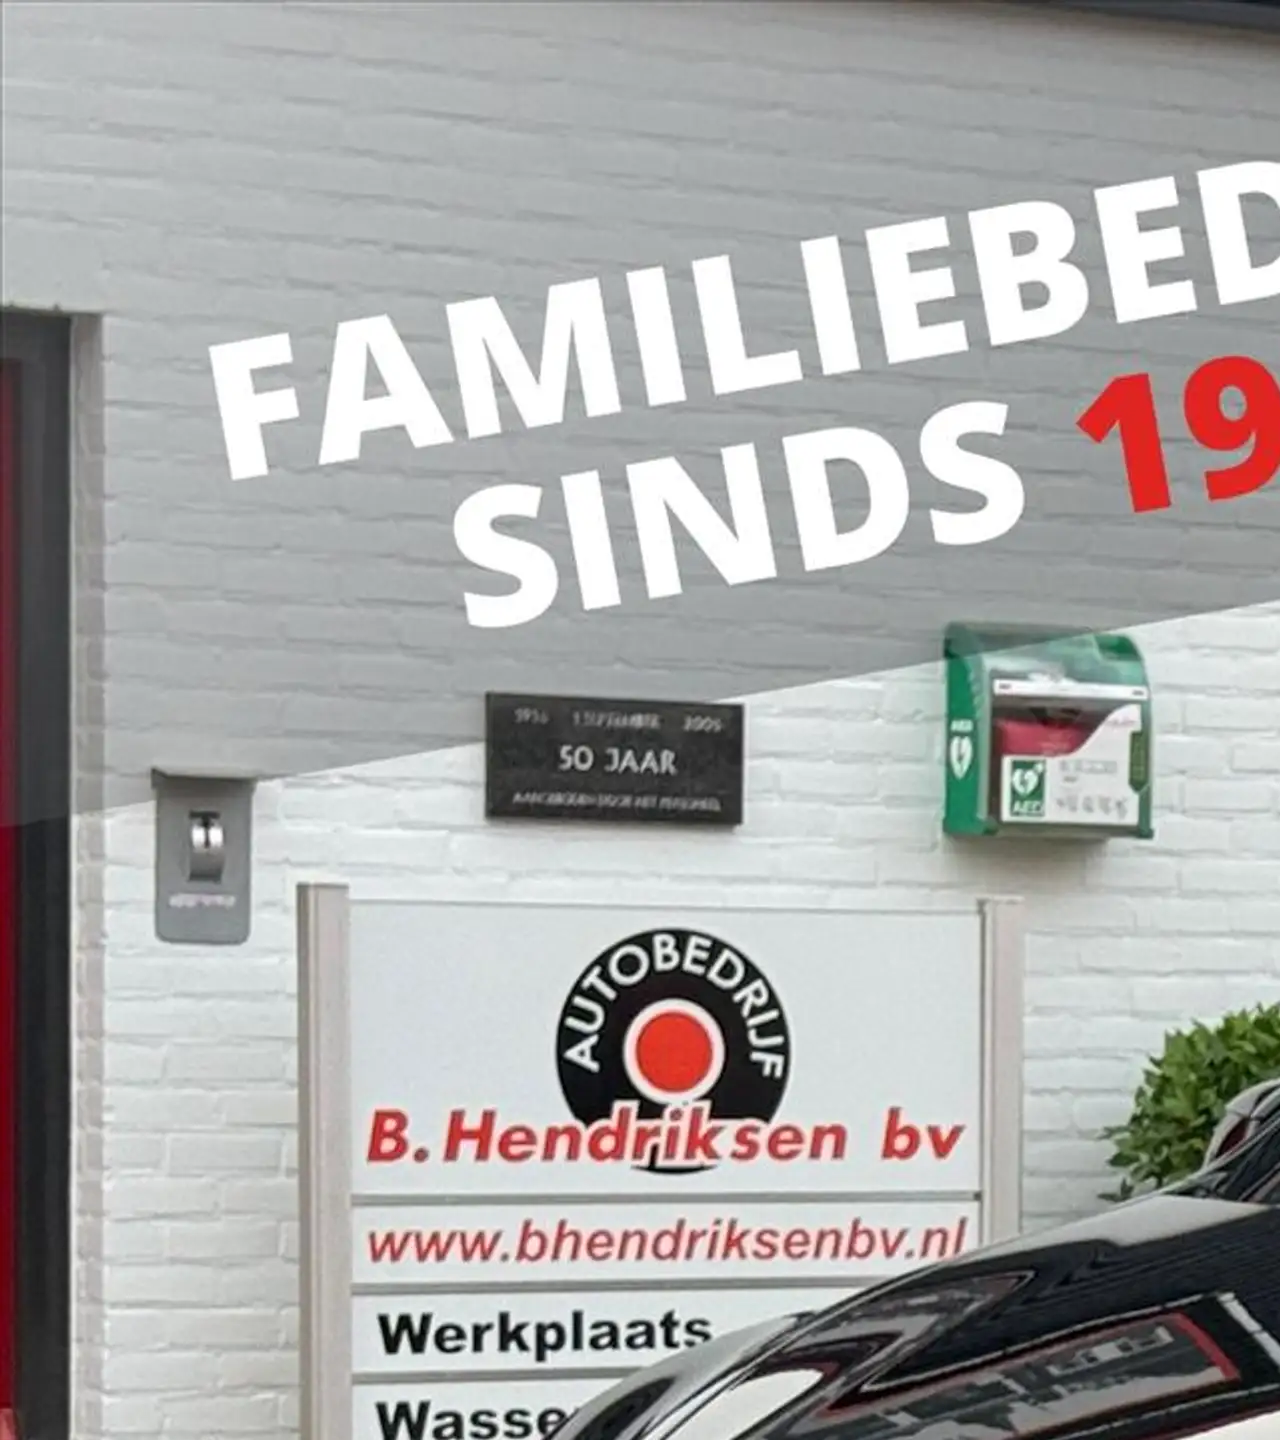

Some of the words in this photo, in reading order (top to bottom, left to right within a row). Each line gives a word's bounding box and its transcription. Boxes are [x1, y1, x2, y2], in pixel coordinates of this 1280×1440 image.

[557, 745, 594, 772] 50
[604, 747, 678, 775] JAAR
[563, 933, 784, 1078] AUTOBEDRIJF
[881, 1106, 966, 1161] bv
[367, 1216, 970, 1264] www.bhendriksenbv.nl
[377, 1309, 713, 1364] Werkplaats
